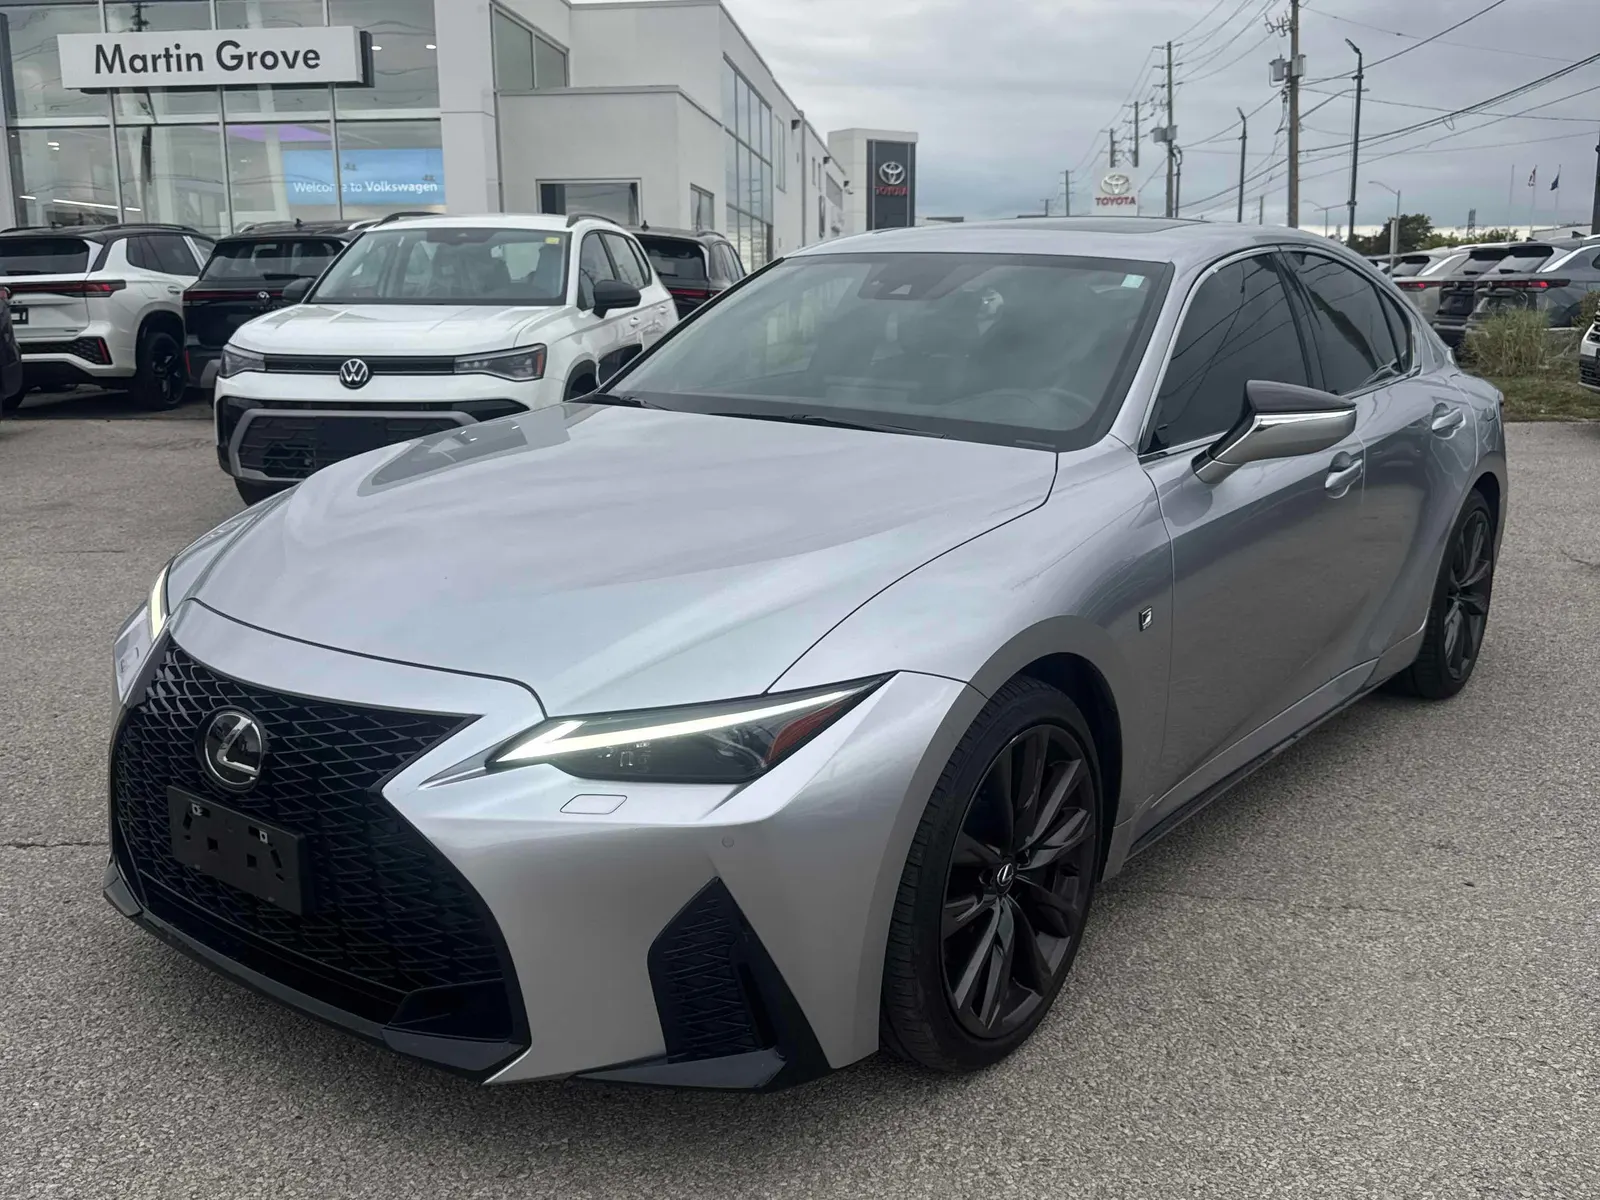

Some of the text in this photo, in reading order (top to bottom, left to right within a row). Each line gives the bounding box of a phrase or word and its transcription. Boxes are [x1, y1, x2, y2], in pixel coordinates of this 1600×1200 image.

[95, 39, 321, 74] Martin Grove
[350, 182, 363, 193] to
[364, 181, 438, 195] Volkswagen
[1095, 196, 1136, 206] TOYOTA
